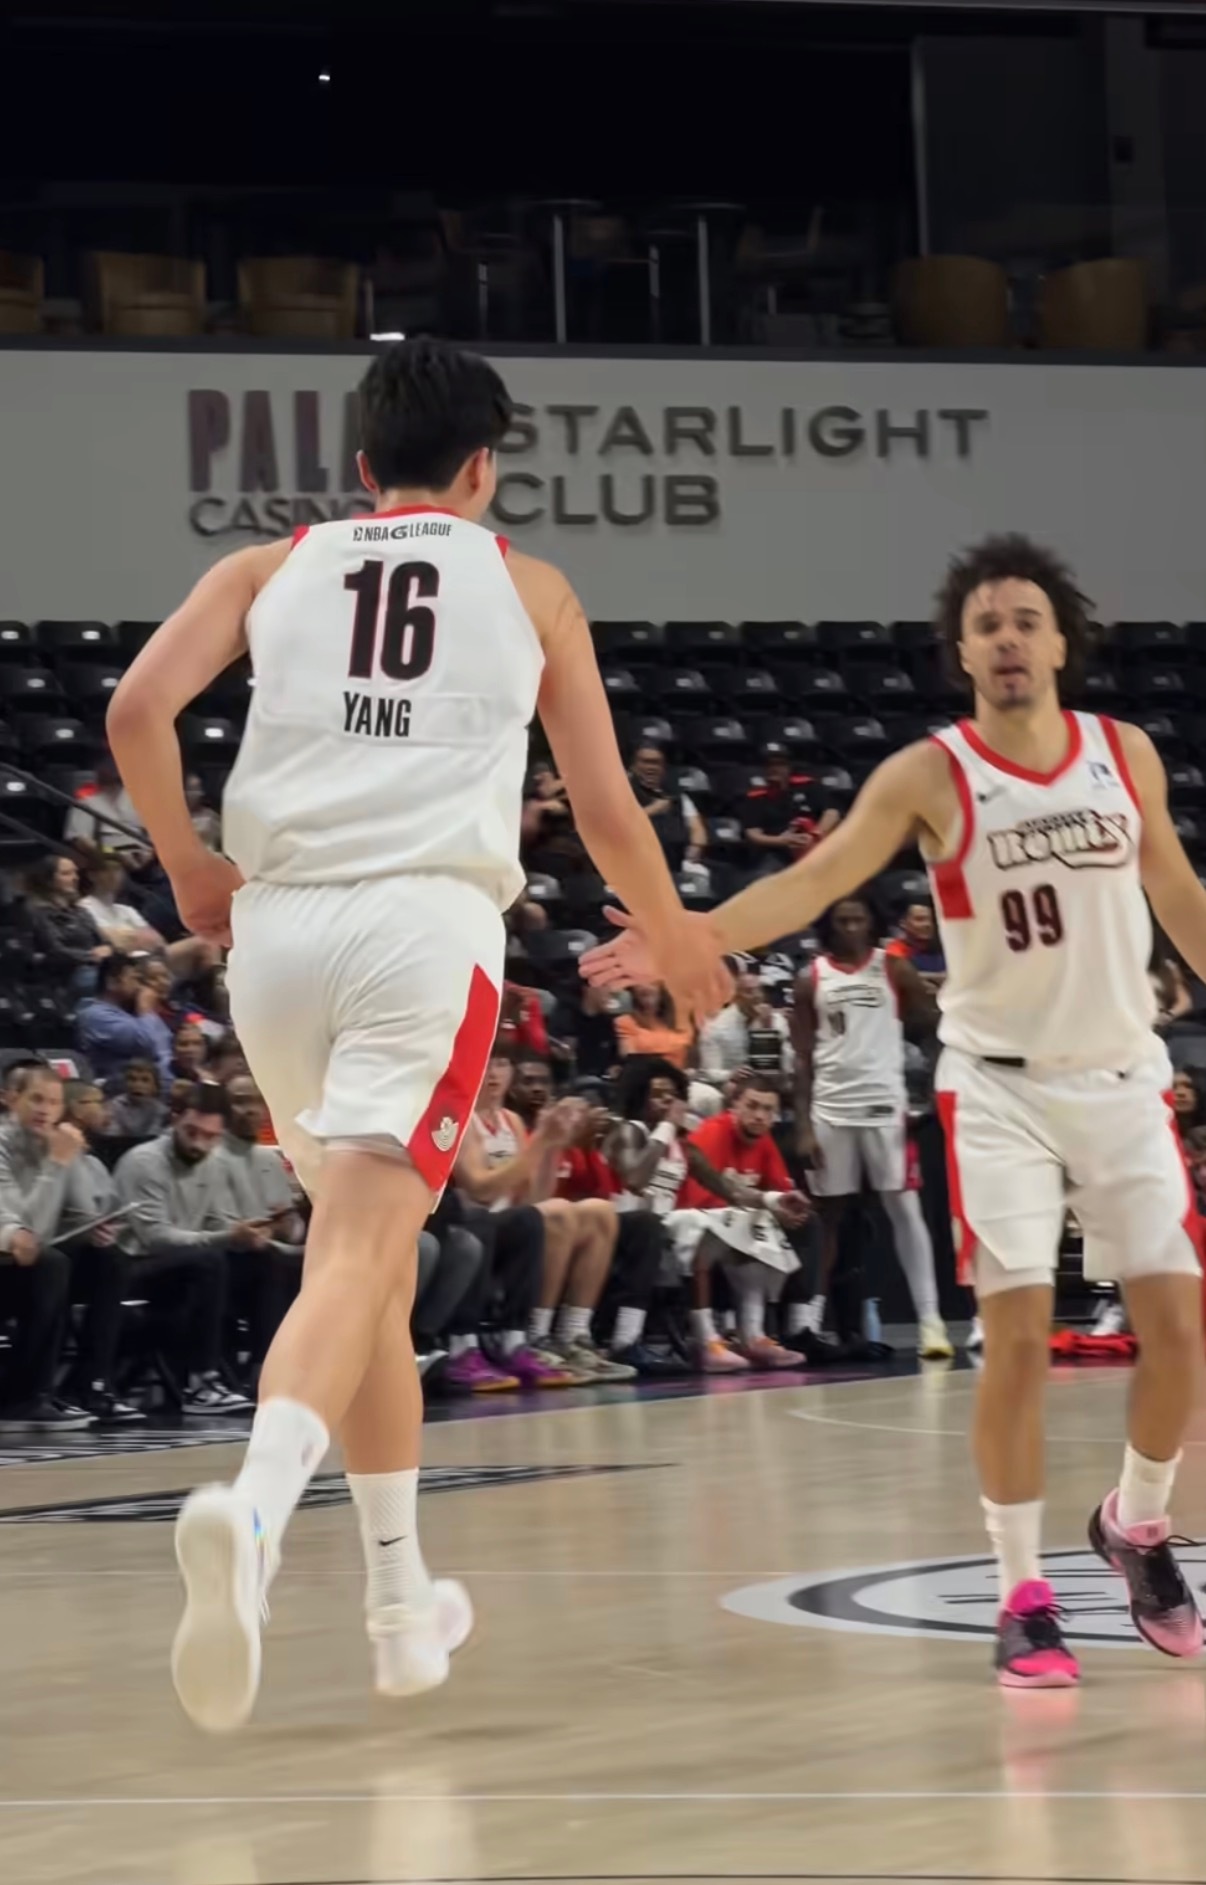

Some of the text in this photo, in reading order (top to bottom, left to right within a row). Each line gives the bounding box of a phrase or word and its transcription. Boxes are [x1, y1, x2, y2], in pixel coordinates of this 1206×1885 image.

[499, 404, 989, 457] STARLIGHT
[492, 472, 719, 526] CLUB
[343, 559, 440, 681] 16
[343, 691, 412, 737] YANG
[1001, 883, 1064, 953] 99
